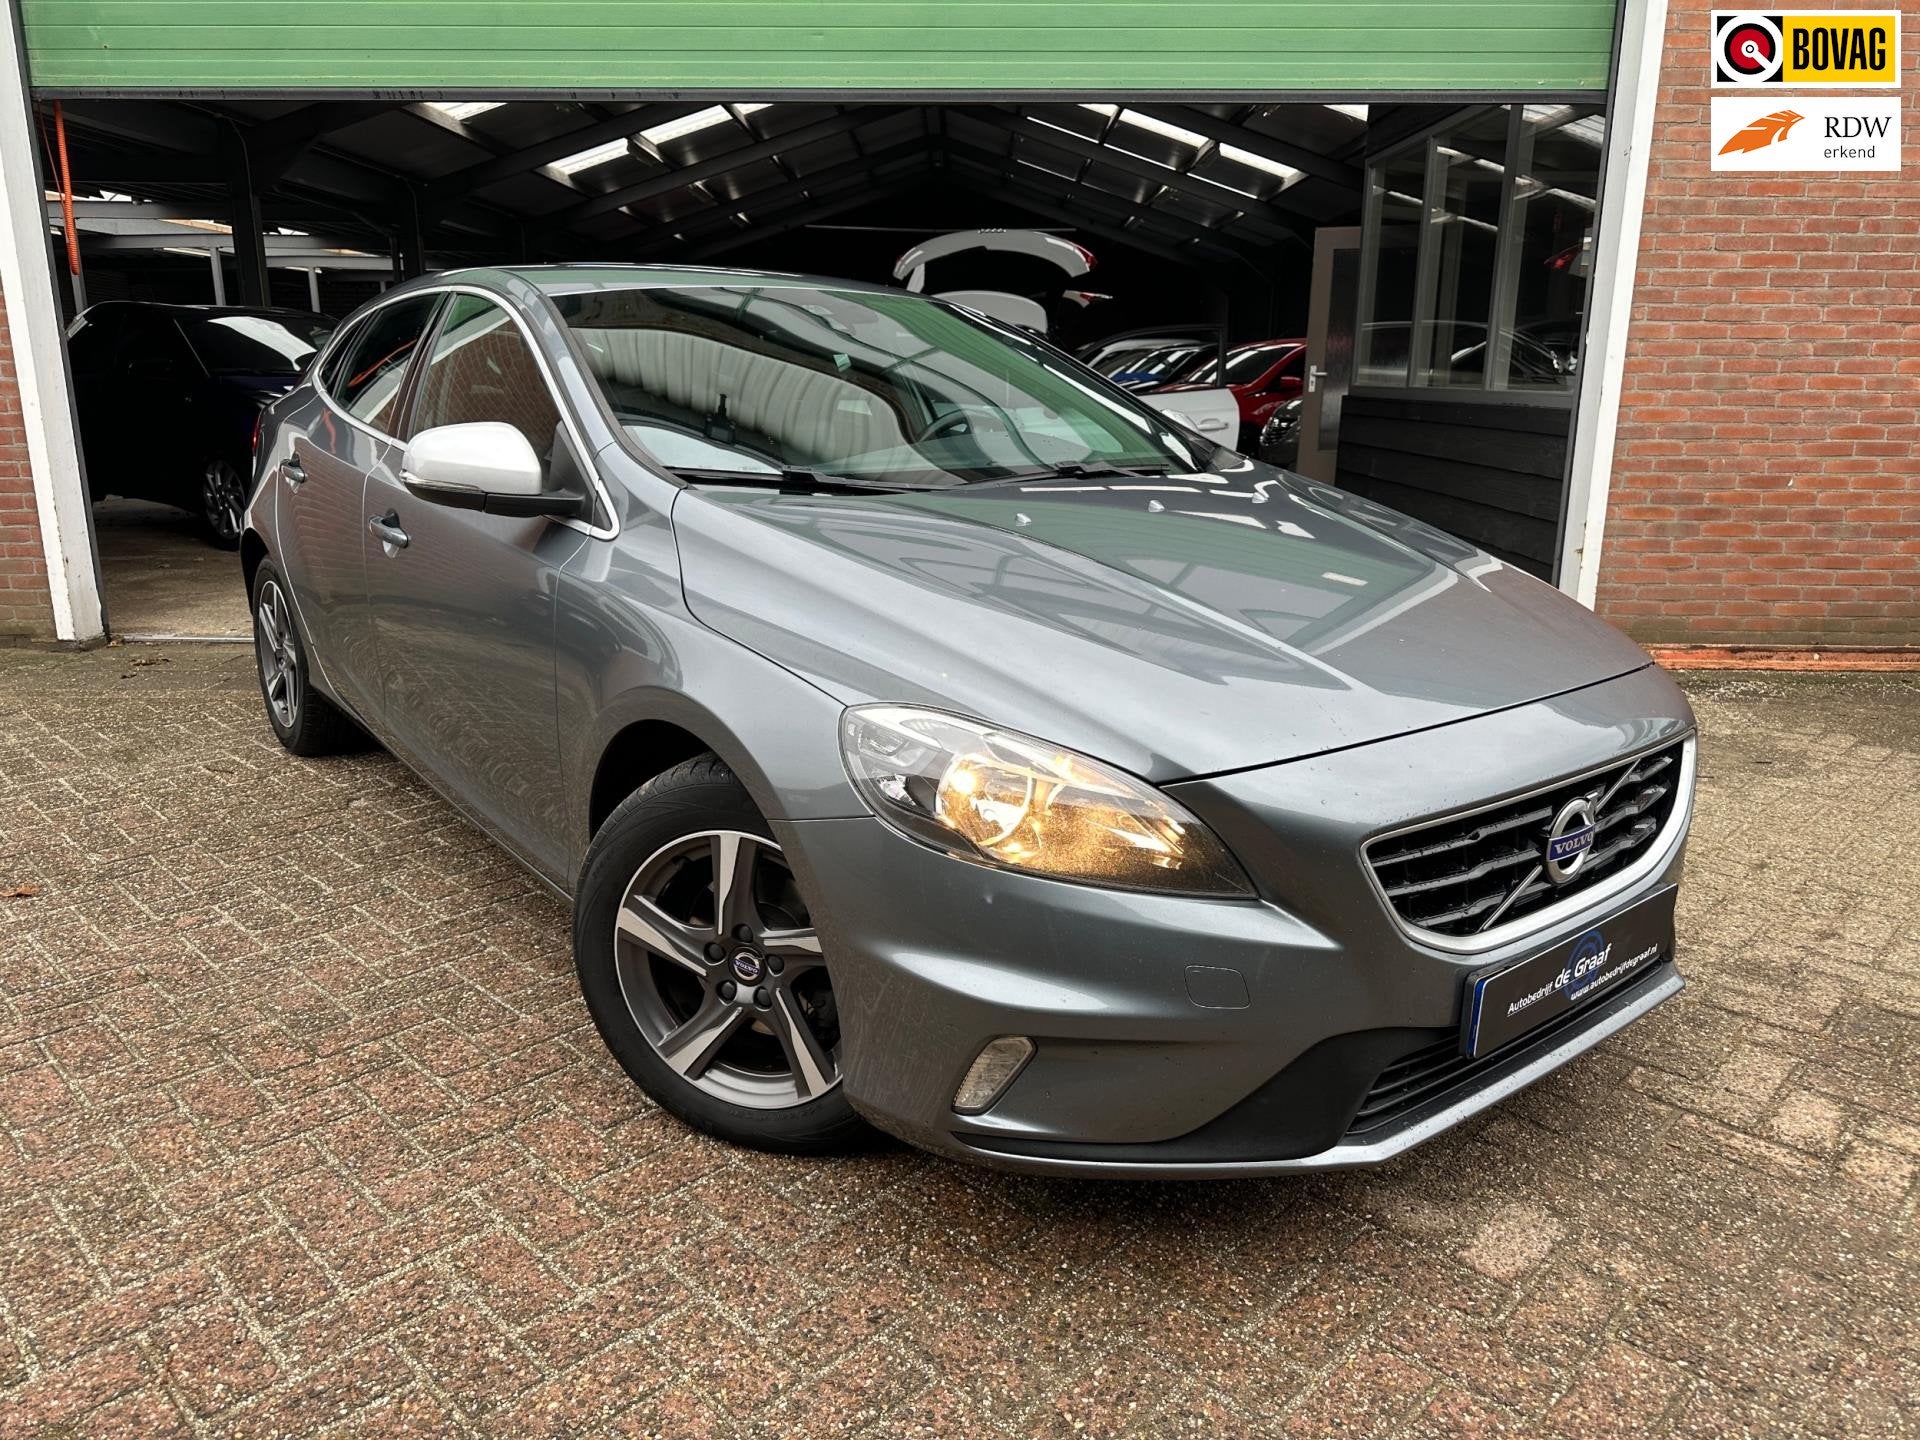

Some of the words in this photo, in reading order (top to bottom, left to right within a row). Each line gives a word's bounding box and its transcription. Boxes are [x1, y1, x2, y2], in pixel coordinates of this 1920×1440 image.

[1554, 831, 1592, 854] VOLVO
[735, 960, 757, 973] VOLVO
[1507, 981, 1554, 1014] Autobedrijf
[1554, 967, 1572, 988] de
[1574, 943, 1612, 977] Graaf
[1571, 944, 1658, 1000] www.autobedrijfdegraaf.nl
